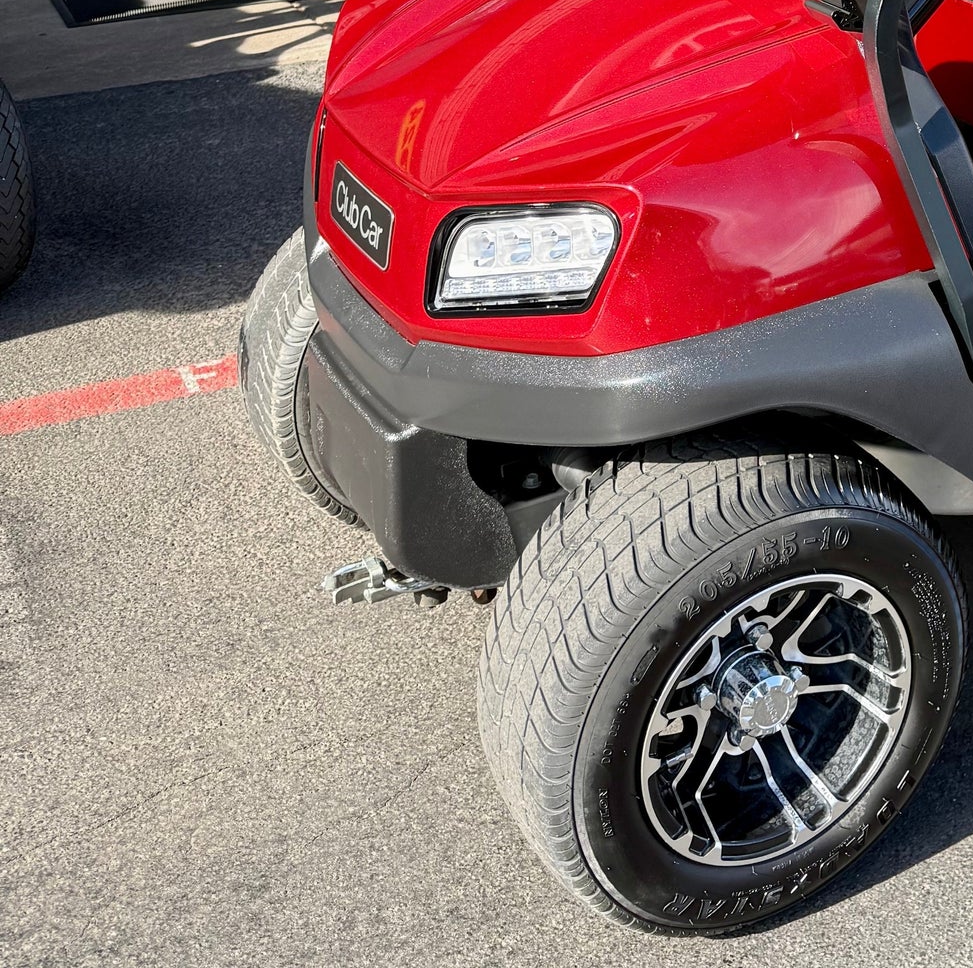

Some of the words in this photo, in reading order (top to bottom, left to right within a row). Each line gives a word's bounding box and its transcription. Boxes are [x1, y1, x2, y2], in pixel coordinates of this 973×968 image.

[336, 180, 360, 229] Club
[359, 204, 384, 250] Car
[678, 525, 850, 622] 205/55-10
